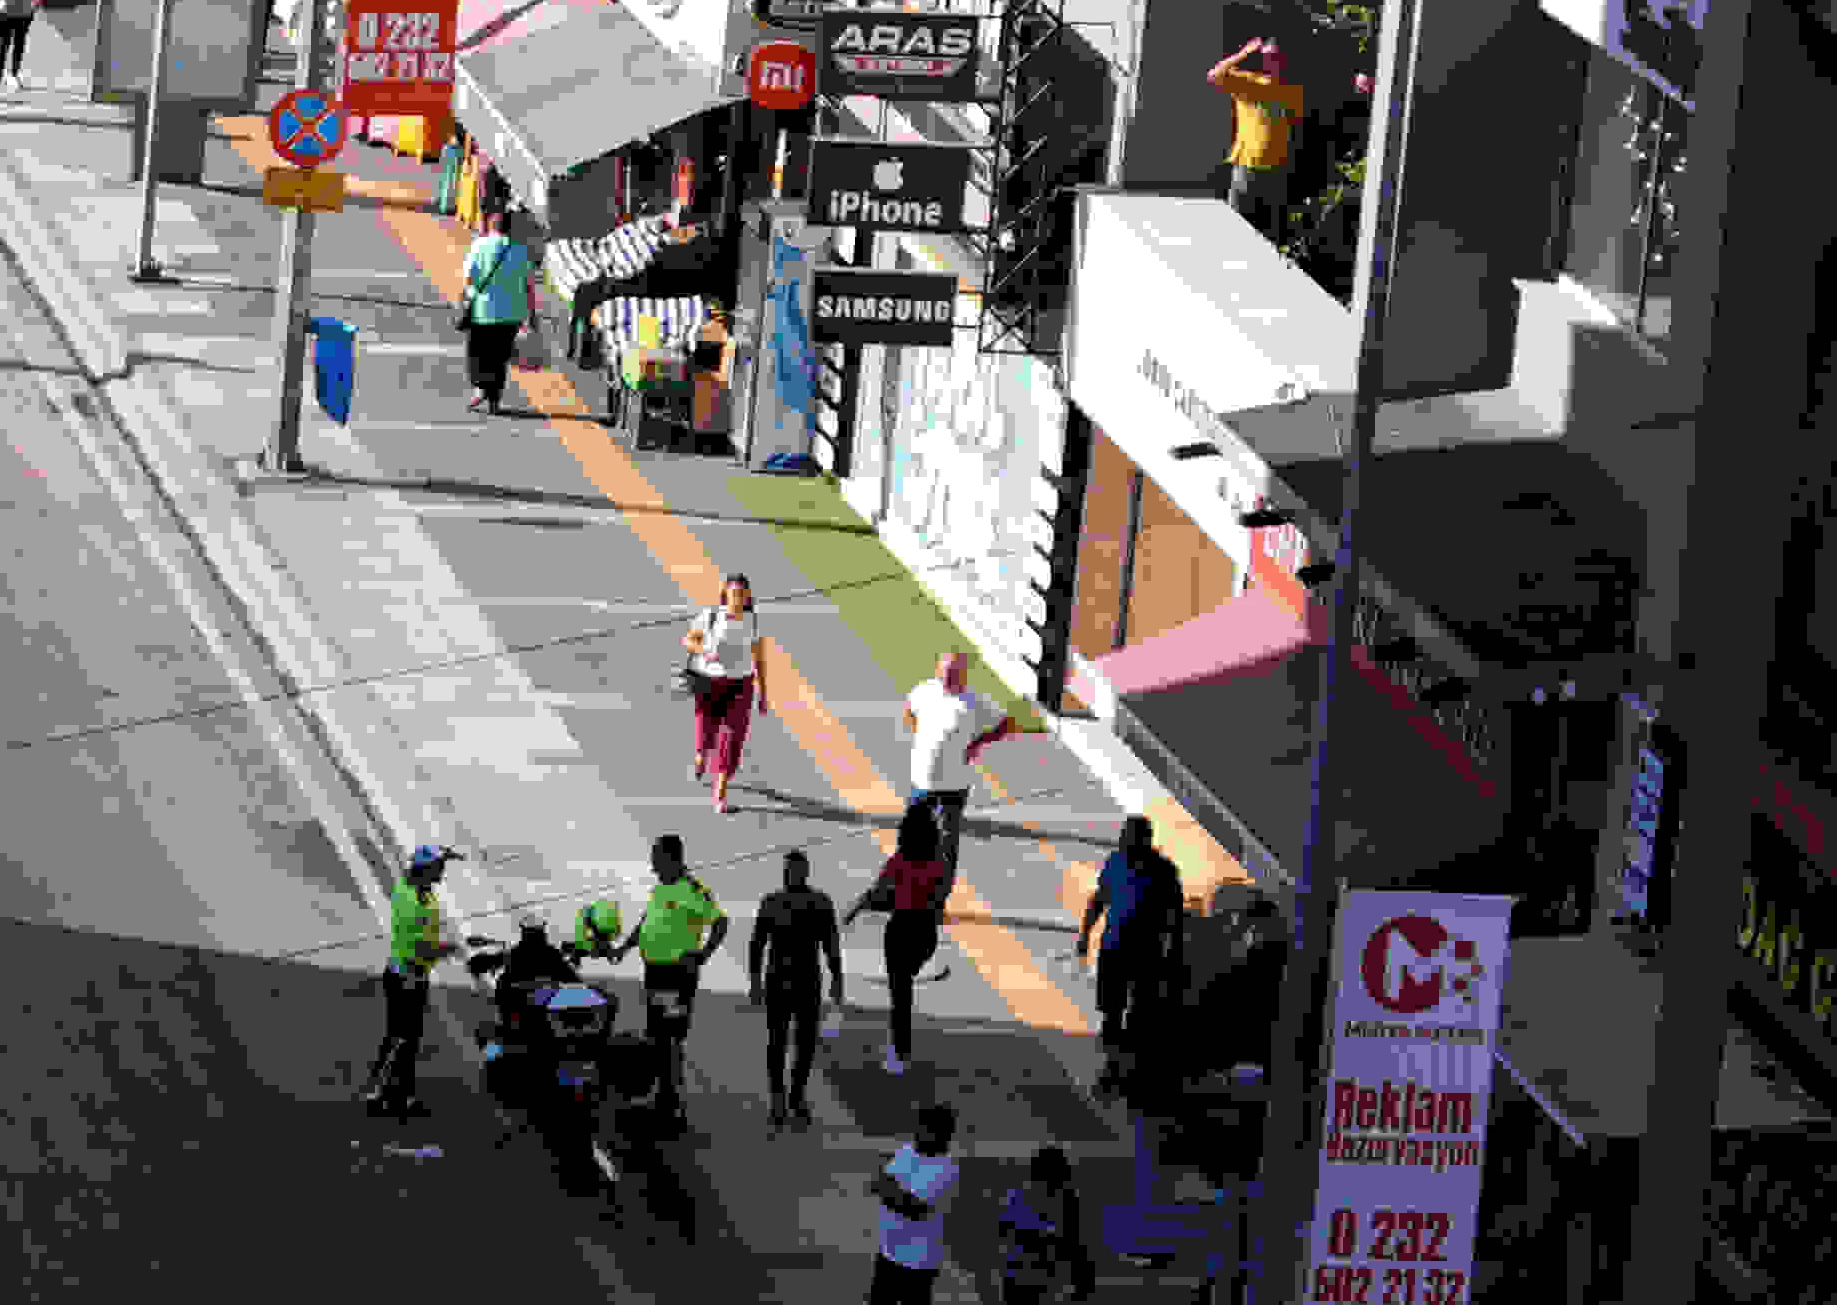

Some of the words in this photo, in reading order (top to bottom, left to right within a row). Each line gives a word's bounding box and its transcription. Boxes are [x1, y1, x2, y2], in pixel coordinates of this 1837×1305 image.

[830, 23, 973, 54] ARAS
[830, 190, 943, 227] iPhone
[815, 293, 952, 323] SAMSUNG
[1333, 1079, 1474, 1134] Reklam
[1327, 1209, 1358, 1259] 0
[1369, 1208, 1452, 1261] 232
